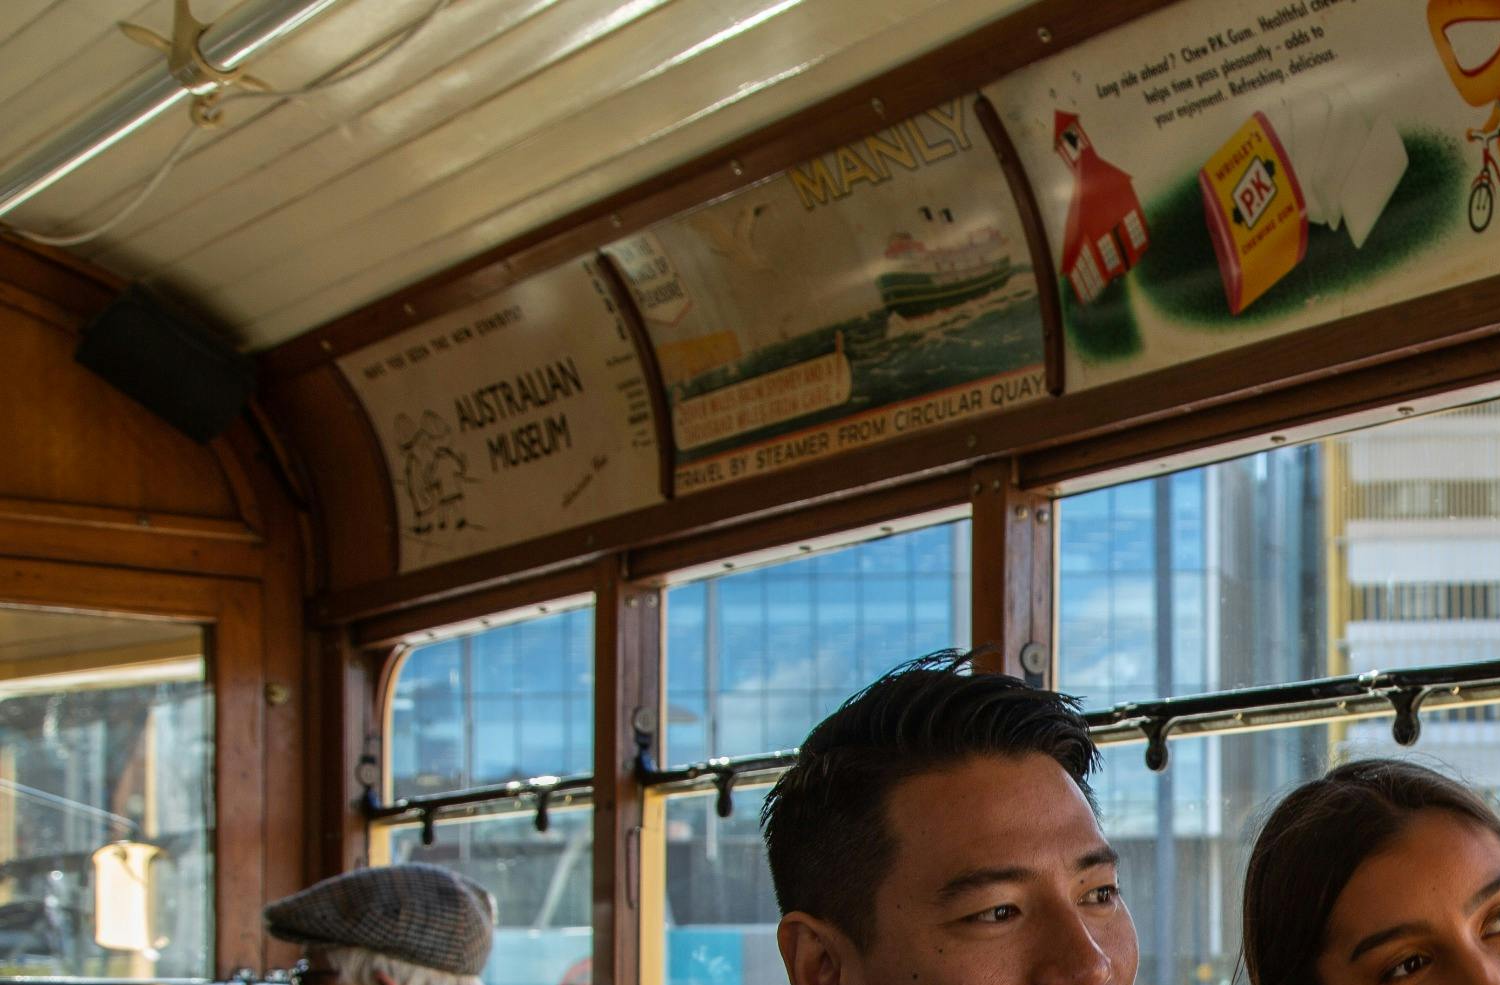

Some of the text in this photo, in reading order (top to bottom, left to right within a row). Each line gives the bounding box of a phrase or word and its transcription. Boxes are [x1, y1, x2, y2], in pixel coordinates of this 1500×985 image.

[1096, 81, 1120, 99] Long
[1120, 70, 1138, 88] ride
[1181, 46, 1208, 62] Chew
[1143, 86, 1171, 105] helps
[1170, 76, 1194, 93] time
[1195, 67, 1219, 88] pass
[1220, 45, 1272, 79] pleasantly
[1284, 29, 1311, 50] adds
[1310, 25, 1325, 39] to
[786, 96, 973, 213] MANLY
[1153, 110, 1175, 130] your
[454, 356, 585, 433] AUSTRALIAN
[485, 411, 573, 474] MUSEUM
[675, 461, 724, 488] TRAVEL
[729, 455, 748, 477] BY
[755, 431, 829, 469] STEAMER
[837, 416, 887, 447] FROM
[894, 389, 983, 431] CIRCULAR
